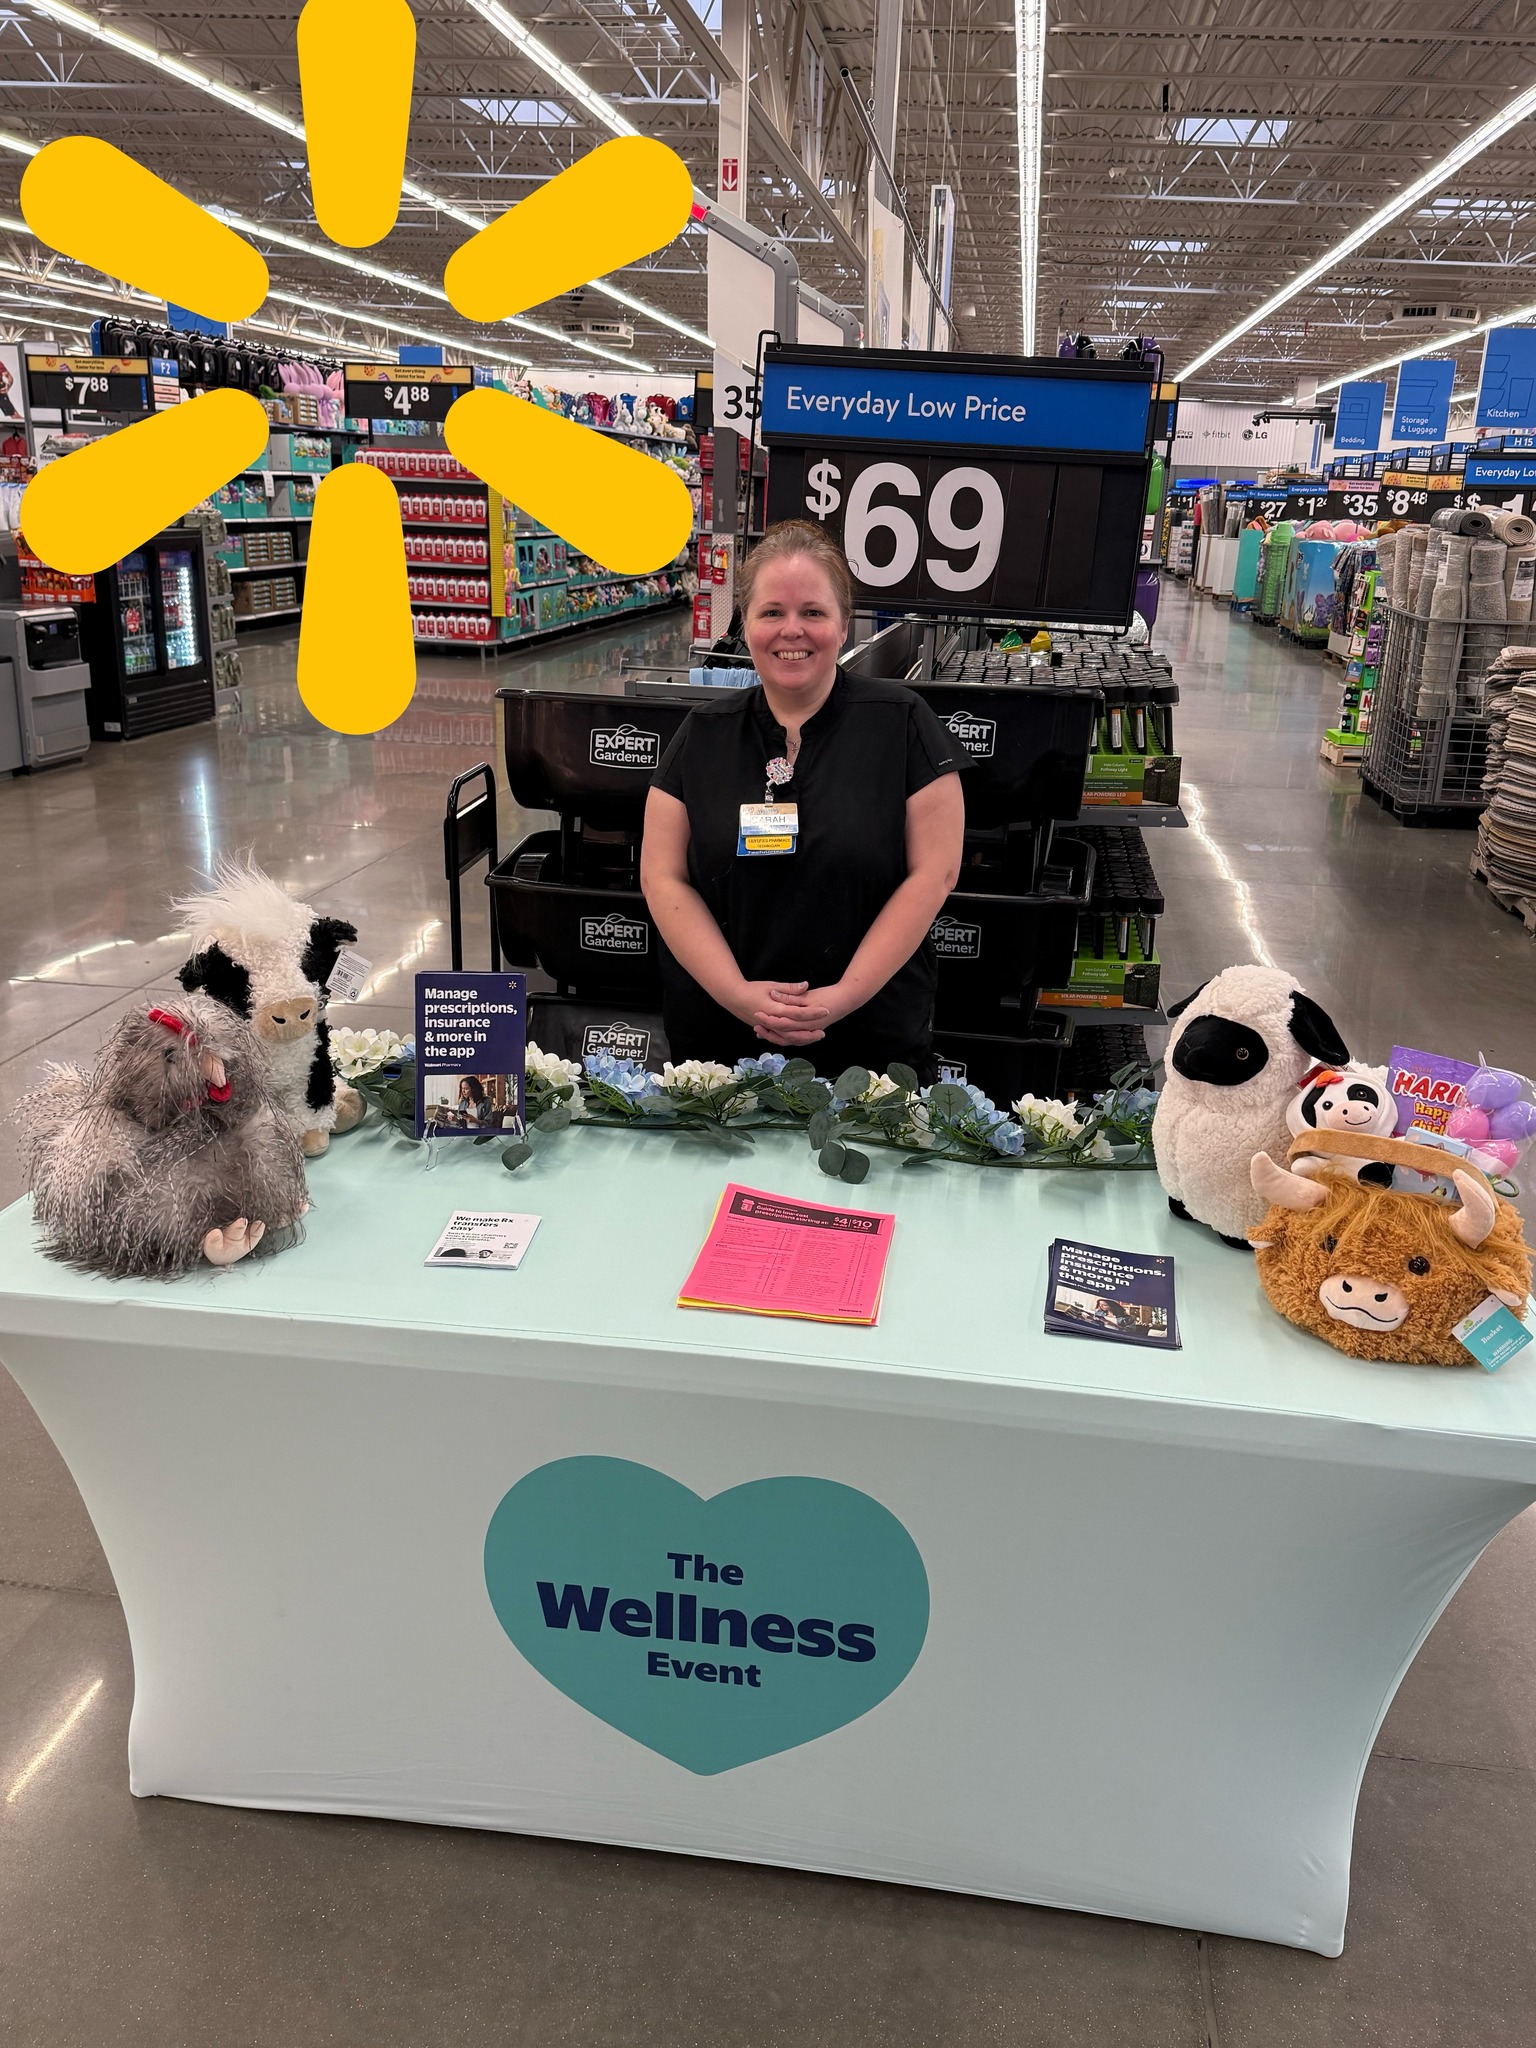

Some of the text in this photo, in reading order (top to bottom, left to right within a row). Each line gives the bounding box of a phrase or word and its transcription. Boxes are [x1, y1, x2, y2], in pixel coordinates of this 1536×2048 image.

[160, 362, 171, 375] F2
[723, 385, 763, 420] 35
[786, 385, 1027, 423] Everyday Low Price
[1401, 415, 1429, 425] Storage
[1486, 408, 1520, 418] Kitchen
[1212, 430, 1231, 439] fitbit
[1255, 431, 1268, 439] LG
[1400, 425, 1438, 435] & Luggage
[1340, 436, 1366, 445] Bedding
[1417, 449, 1432, 457] H19
[1475, 467, 1521, 480] Everyday
[805, 458, 1005, 592] $69
[948, 723, 992, 739] PERT
[595, 734, 656, 752] EXPERT
[594, 748, 655, 764] Gardener
[585, 922, 644, 939] EXPERT
[934, 927, 977, 943] PERT
[584, 935, 644, 950] Gardener
[424, 988, 478, 1001] Manage
[424, 1002, 518, 1016] prescriptions,
[424, 1016, 491, 1028] insurance
[424, 1030, 487, 1042] & more in
[588, 1030, 646, 1047] EXPERT
[424, 1045, 475, 1058] the app
[586, 1043, 644, 1058] Gadener
[1414, 1101, 1451, 1124] Happ
[834, 1216, 873, 1228] $4 $10
[1061, 1245, 1121, 1263] Manage
[1060, 1252, 1166, 1277] prescriptions,
[1060, 1258, 1135, 1280] insurance
[1058, 1271, 1116, 1291] the app
[1072, 1267, 1113, 1283] more
[1115, 1278, 1130, 1287] in
[1481, 1325, 1503, 1344] Basket
[667, 1552, 744, 1586] The
[536, 1581, 877, 1663] Wellness
[647, 1651, 762, 1688] Event
